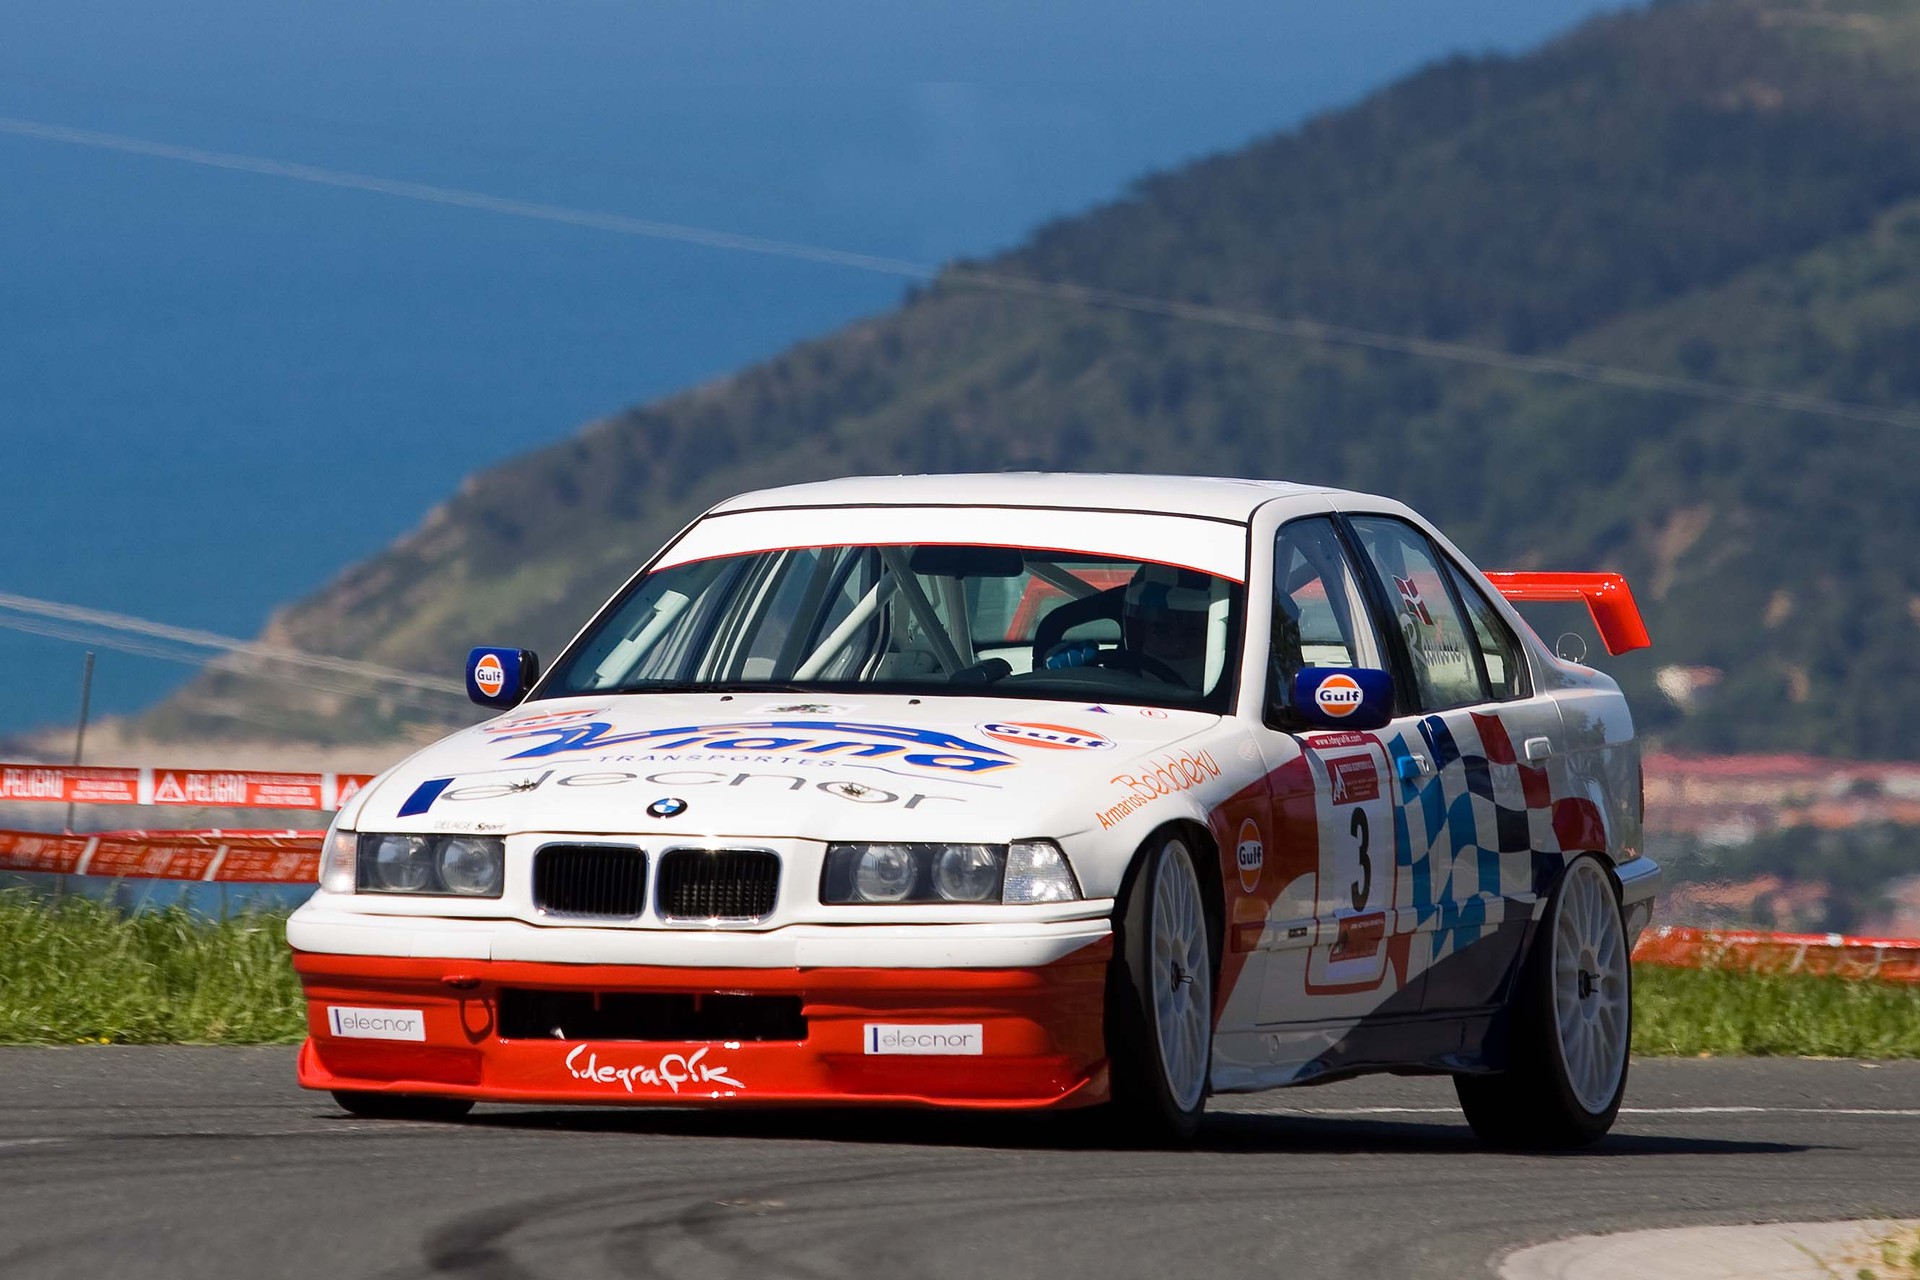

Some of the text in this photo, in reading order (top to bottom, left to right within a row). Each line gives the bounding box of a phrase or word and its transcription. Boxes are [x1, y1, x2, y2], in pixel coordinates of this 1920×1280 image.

[477, 669, 501, 682] Gulf
[1319, 690, 1360, 702] Gulf
[984, 724, 1109, 748] Gulf
[599, 754, 837, 767] TRANSPORTES
[441, 769, 967, 811] elecnor
[1095, 793, 1148, 831] Armarios
[1239, 845, 1262, 866] Gulf
[1350, 807, 1372, 912] 3
[343, 1012, 416, 1032] elecnor
[882, 1029, 974, 1047] elecnor
